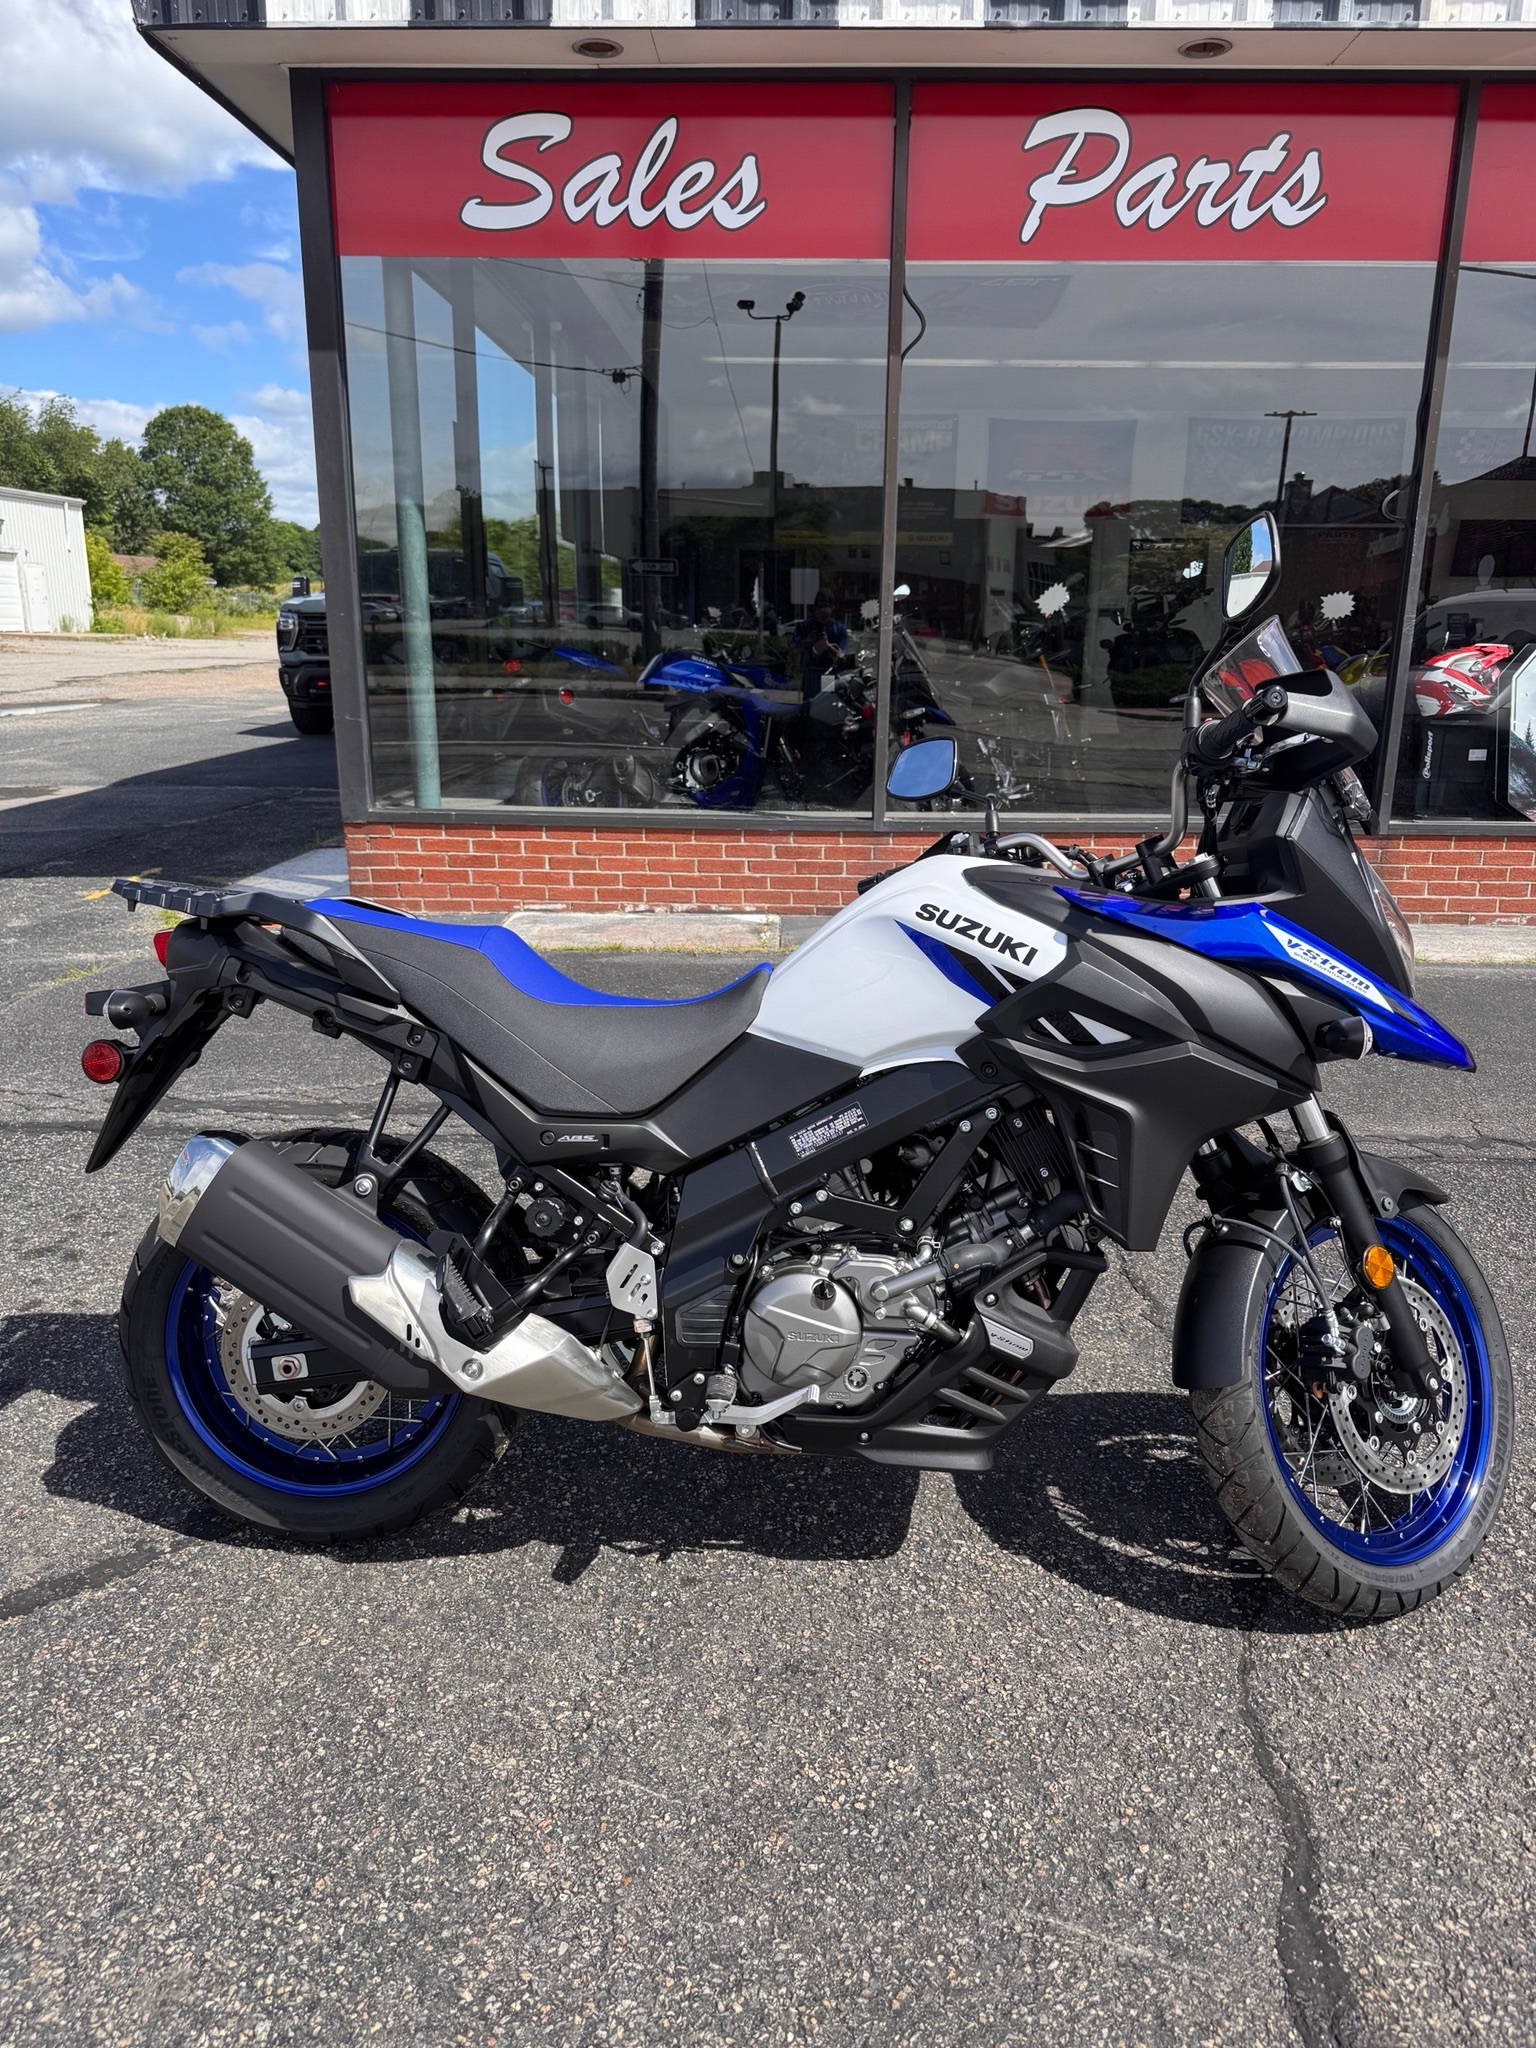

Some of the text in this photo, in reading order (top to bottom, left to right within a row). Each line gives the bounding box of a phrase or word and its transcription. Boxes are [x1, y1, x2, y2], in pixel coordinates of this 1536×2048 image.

[460, 111, 767, 232] Sales
[1019, 105, 1328, 244] Parts
[1422, 730, 1434, 779] Polisport
[915, 903, 1038, 966] SUZUKI
[1287, 938, 1371, 991] V-Strom
[787, 1331, 840, 1344] SUZUKI
[1471, 1376, 1511, 1532] BRIDGESTONE
